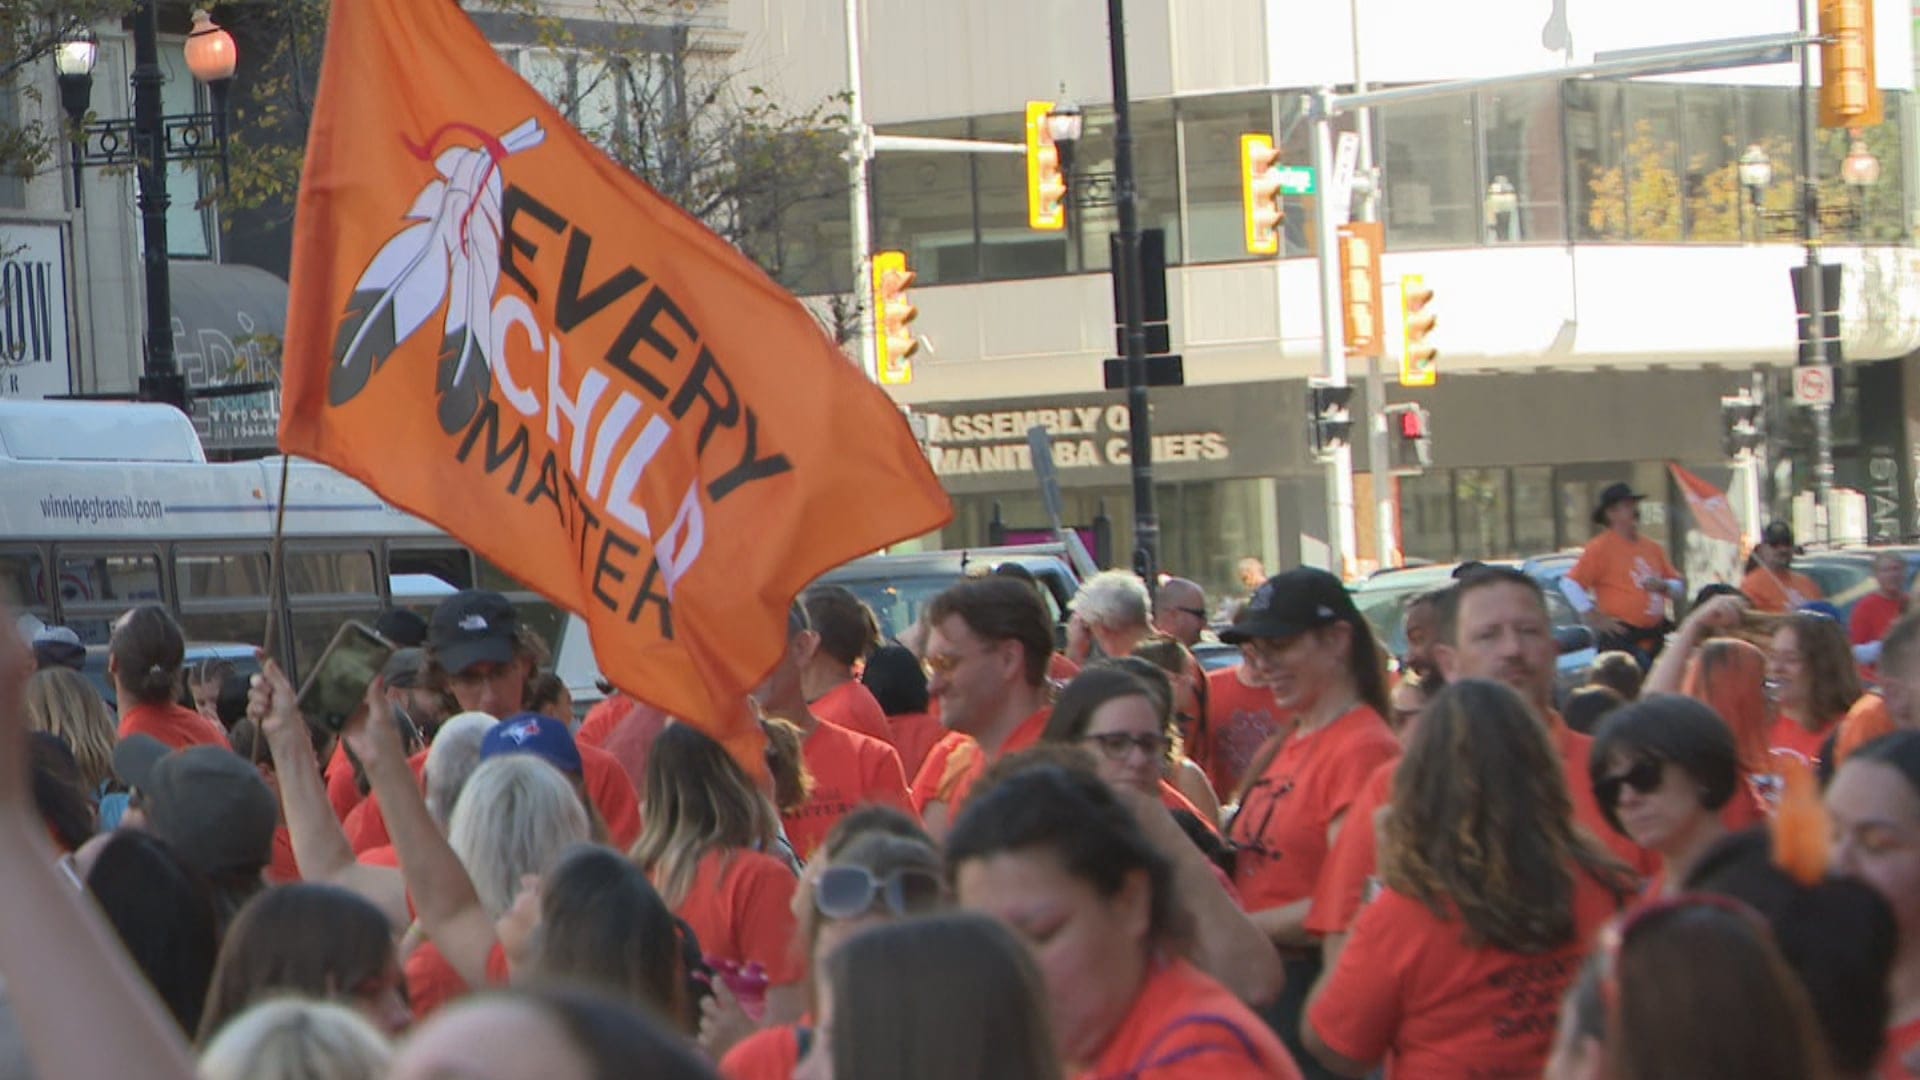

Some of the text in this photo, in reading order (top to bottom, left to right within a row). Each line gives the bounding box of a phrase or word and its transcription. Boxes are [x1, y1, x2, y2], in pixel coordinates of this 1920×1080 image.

[0, 260, 52, 363] OW
[499, 184, 793, 503] EVERY
[491, 294, 705, 604] CHILD
[926, 406, 1101, 442] ASSEMBLY
[928, 431, 1230, 475] MANITBA CIEFS
[40, 493, 163, 523] winnipegtransit.com
